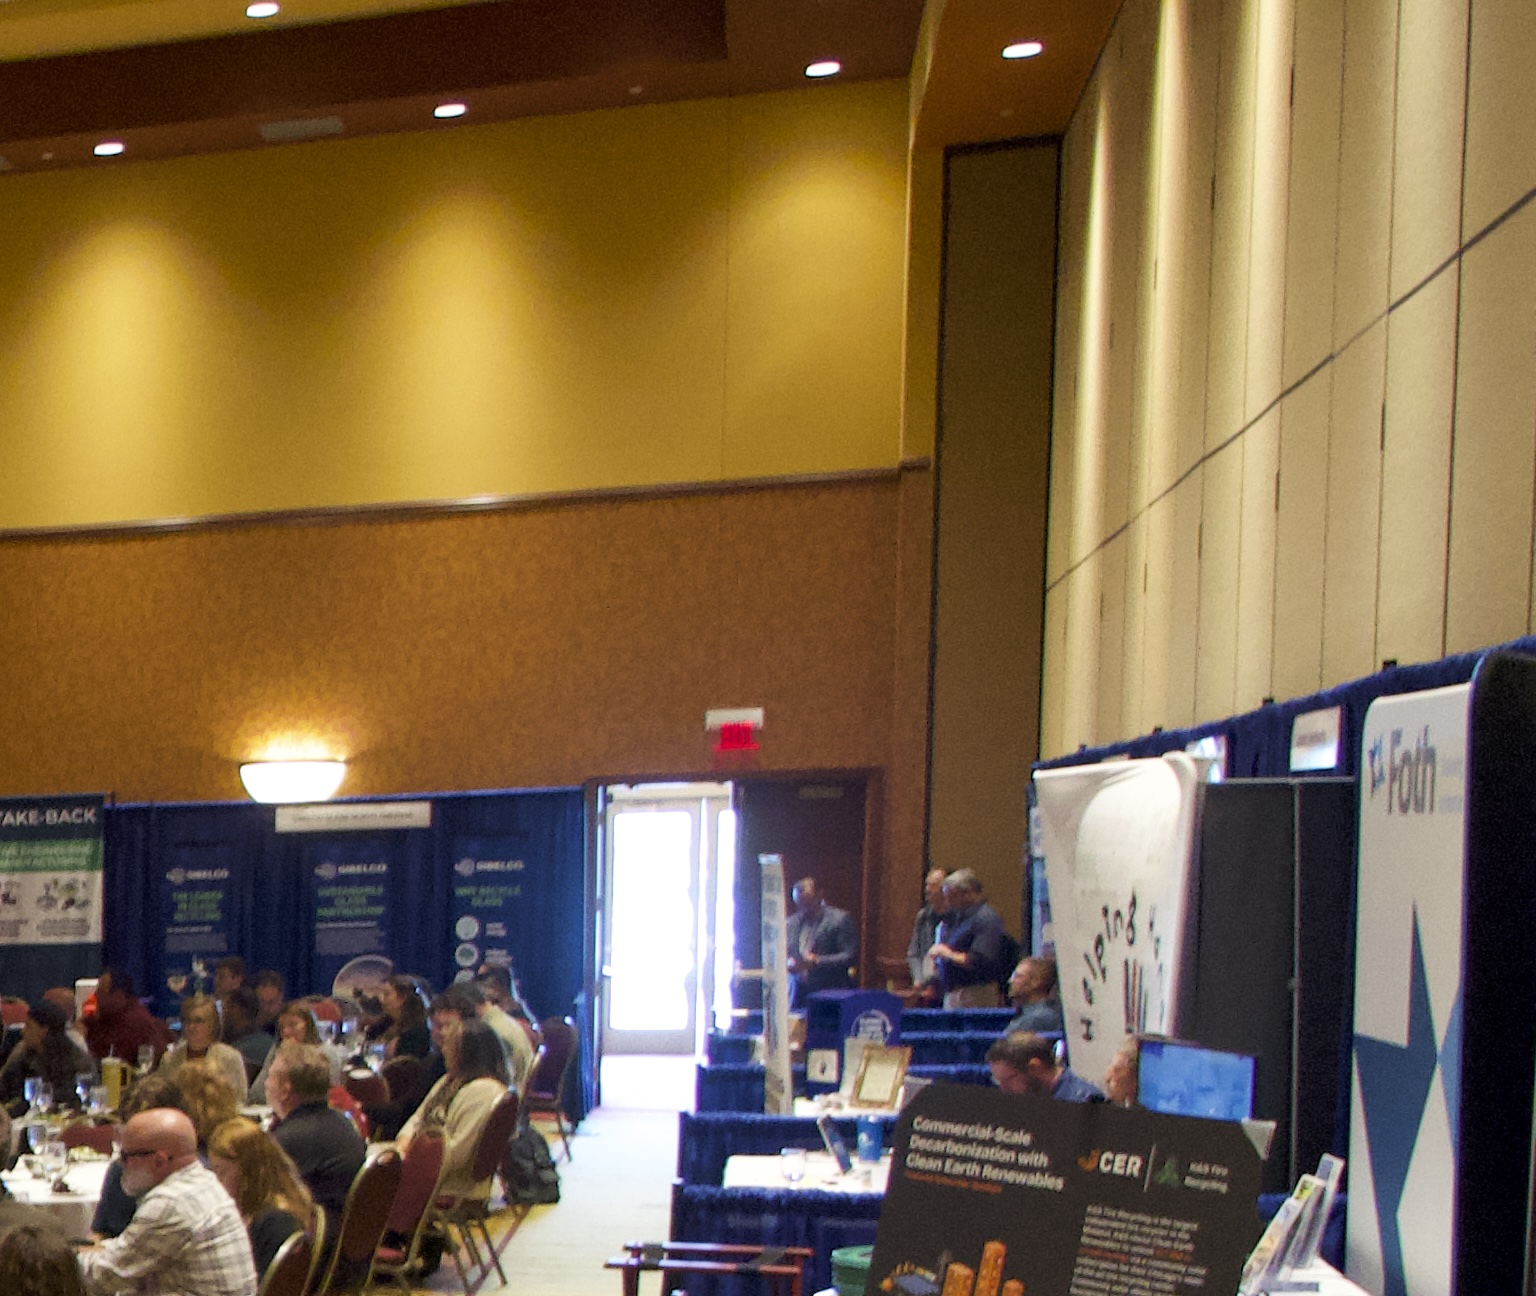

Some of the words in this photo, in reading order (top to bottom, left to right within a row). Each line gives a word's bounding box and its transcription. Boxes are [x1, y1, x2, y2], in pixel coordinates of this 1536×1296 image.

[913, 1114, 1033, 1147] Commercial-Scale
[909, 1133, 1016, 1163] Decarbonization
[1017, 1151, 1050, 1168] with
[1099, 1150, 1143, 1178] CER
[906, 1151, 942, 1171] Clean
[944, 1157, 981, 1177] Earth
[982, 1163, 1065, 1192] Renewables
